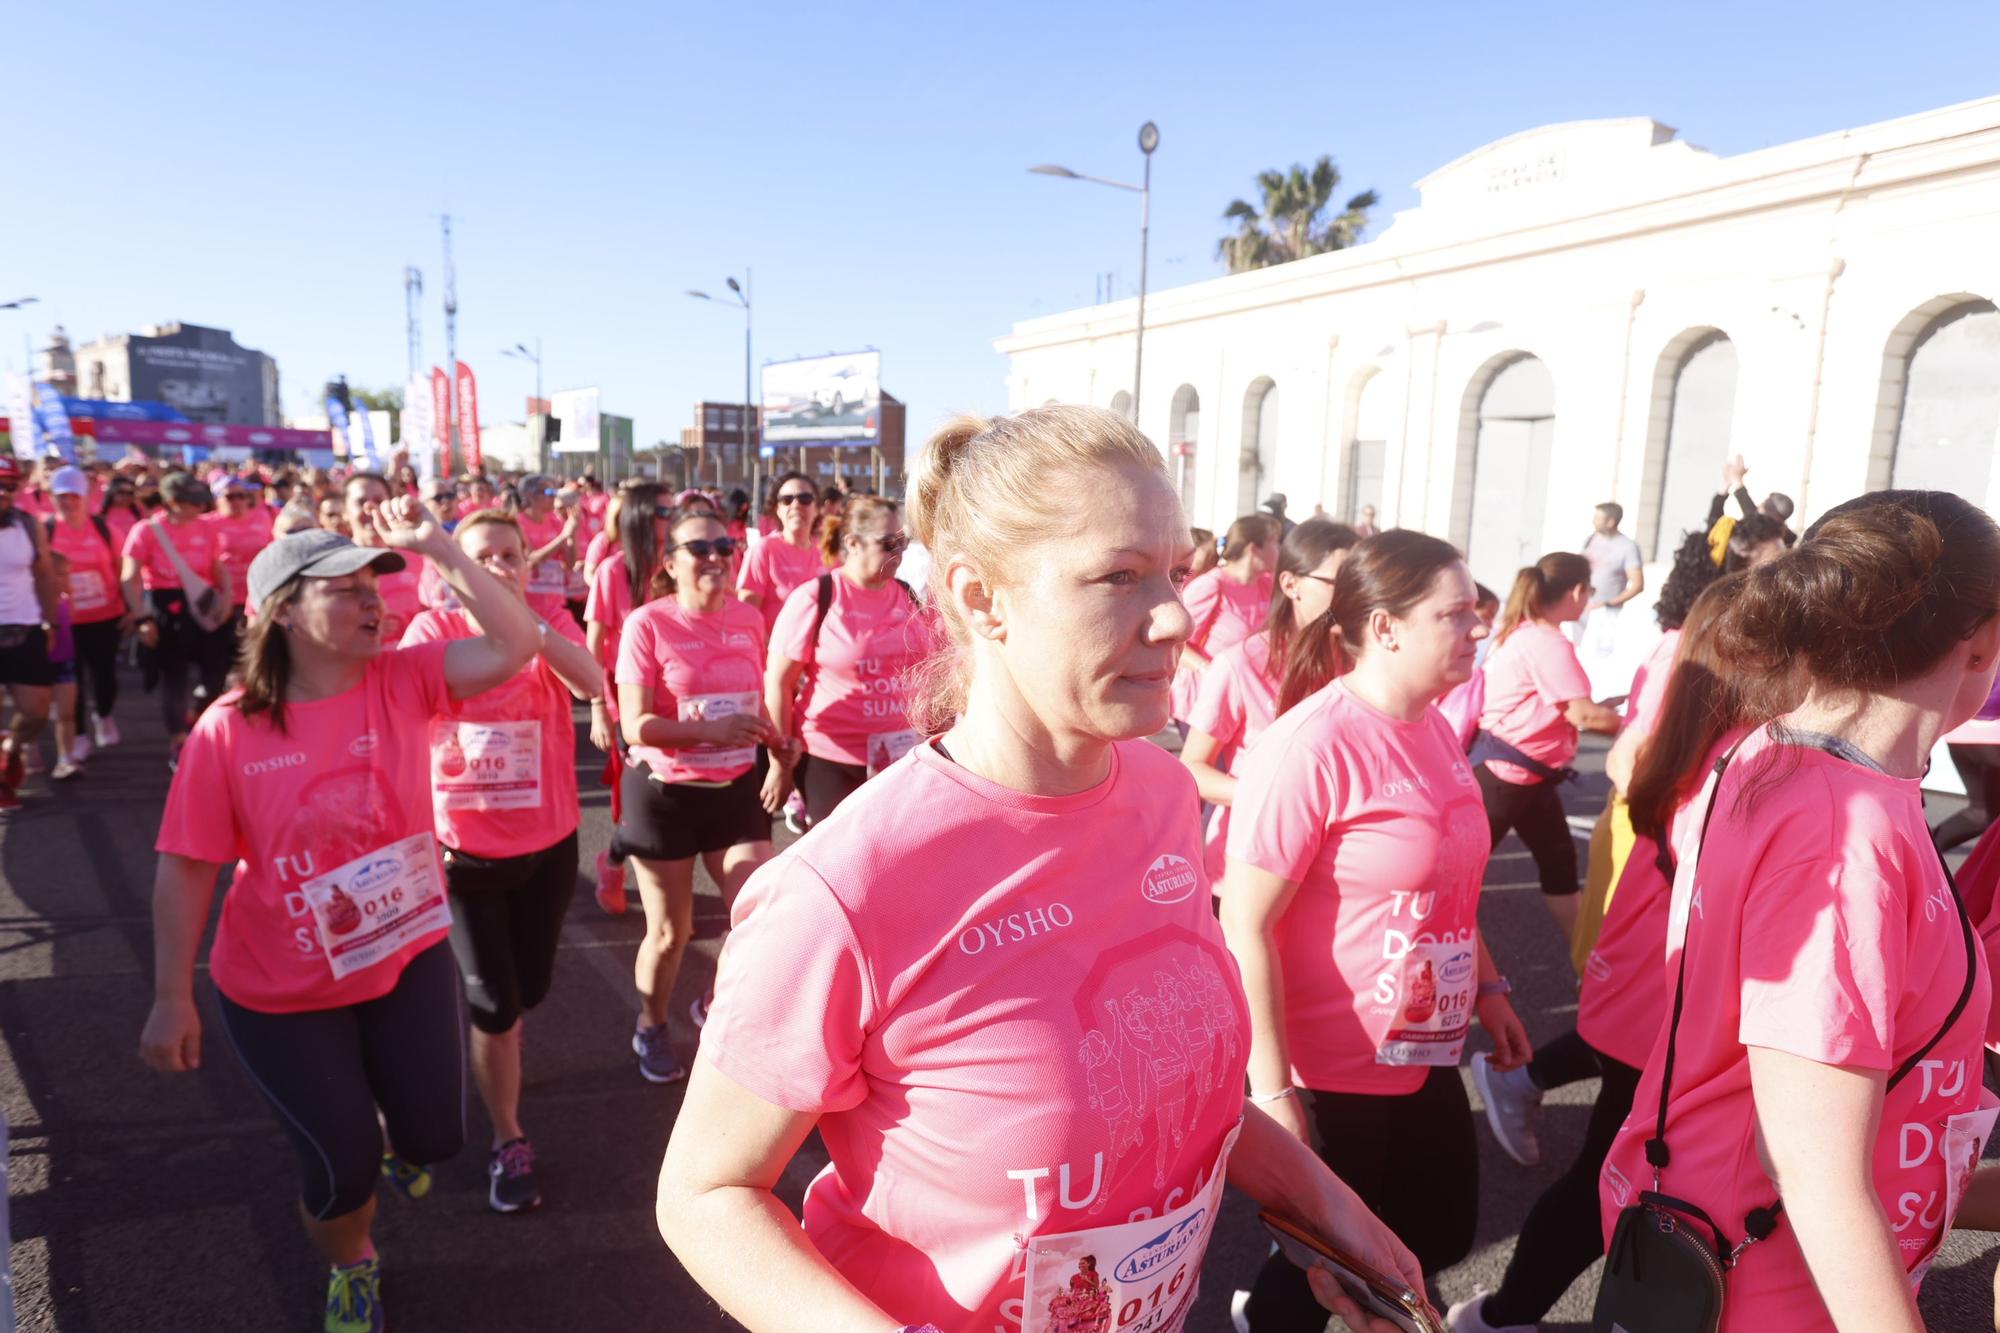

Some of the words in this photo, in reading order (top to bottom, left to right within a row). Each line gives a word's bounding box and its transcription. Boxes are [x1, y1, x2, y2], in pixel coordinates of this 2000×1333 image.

[243, 751, 307, 777] OYSHO
[469, 757, 505, 771] 016
[273, 850, 315, 882] TU
[284, 892, 309, 919] D
[364, 887, 403, 916] 016
[1390, 890, 1436, 921] TU
[958, 902, 1073, 955] OYSHO
[1439, 990, 1467, 1012] 016
[1915, 1058, 1965, 1105] TU
[1007, 1151, 1103, 1221] TU
[1891, 1190, 1942, 1232] SU
[1122, 1220, 1200, 1279] ASTURIANA
[1117, 1263, 1187, 1326] 016
